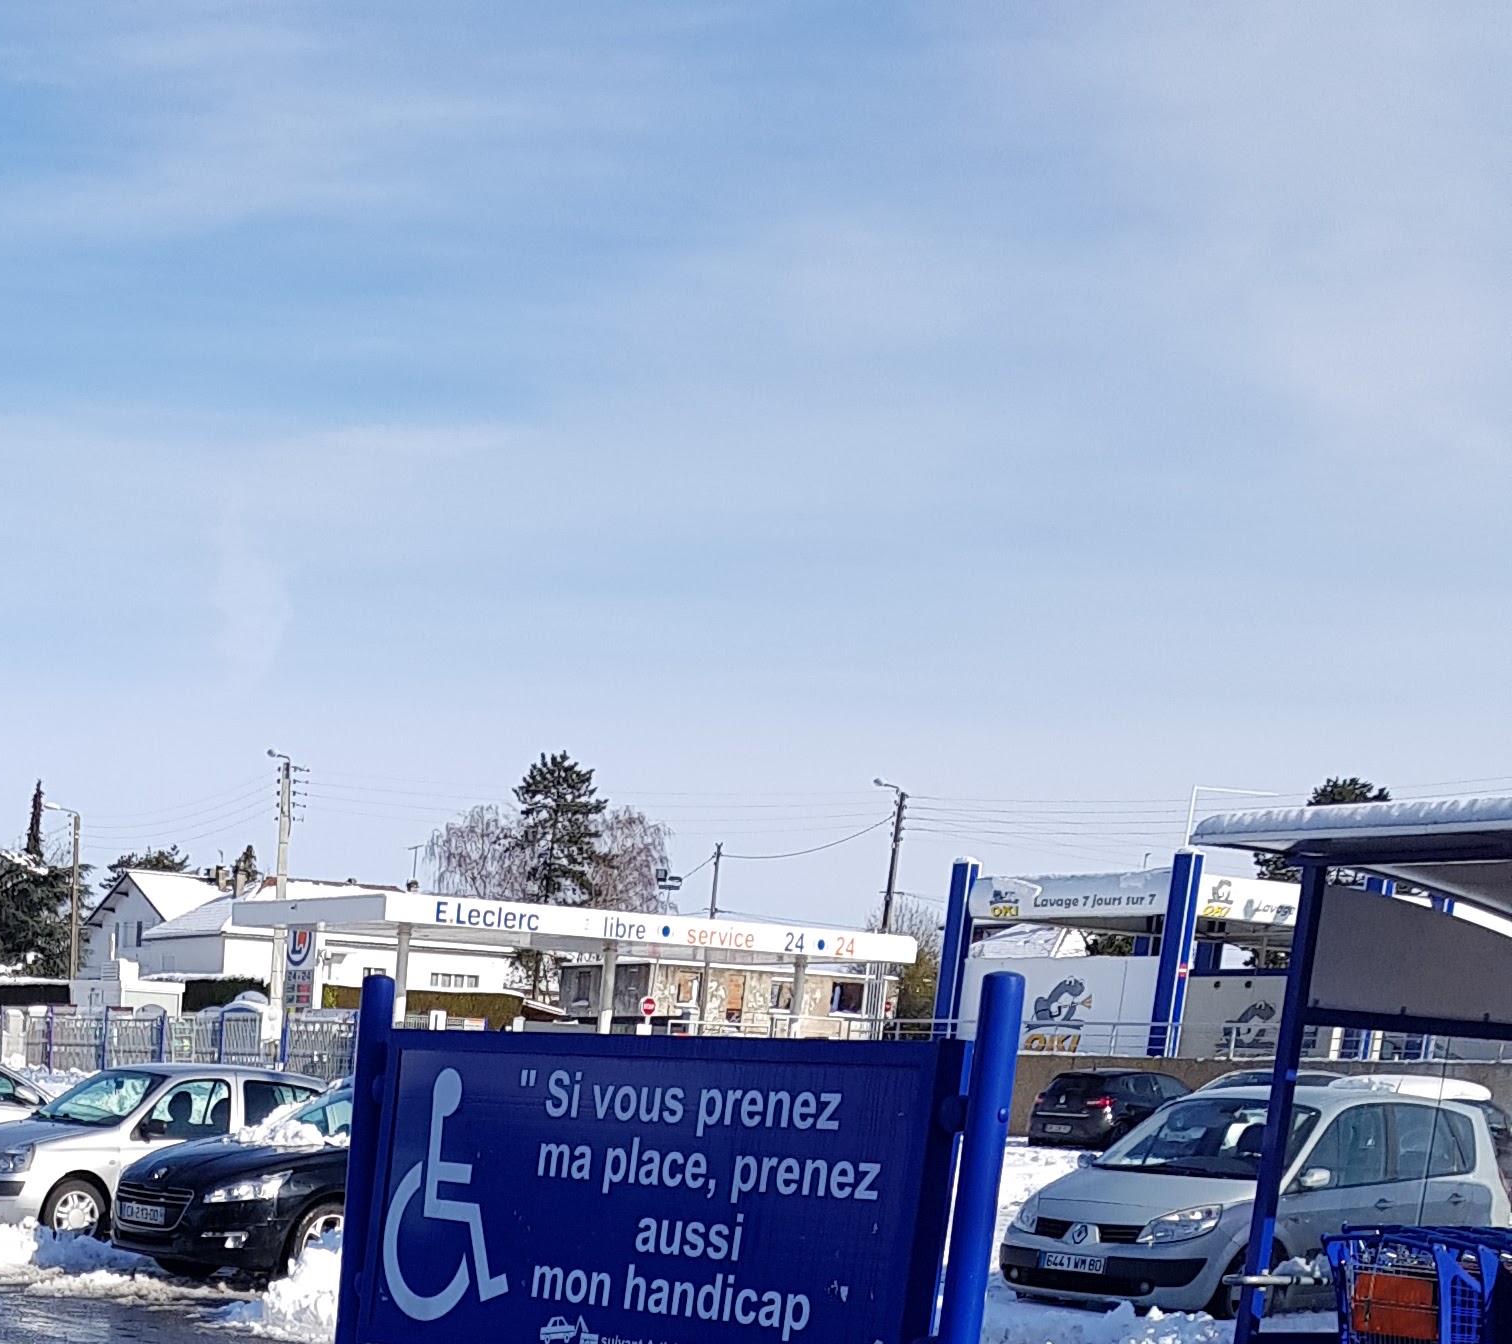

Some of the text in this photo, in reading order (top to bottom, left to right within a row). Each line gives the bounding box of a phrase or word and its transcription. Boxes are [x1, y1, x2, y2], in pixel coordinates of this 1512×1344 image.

[1034, 894, 1156, 908] Lavage 7 jours sur 7
[435, 901, 856, 957] E.Leclerc libre service 24 24
[593, 1085, 685, 1124] vous
[696, 1088, 842, 1137] prenez
[537, 1136, 881, 1204] ma place, prenez
[635, 1213, 744, 1261] aussi
[1047, 1254, 1072, 1268] 6441
[530, 1264, 611, 1307] mon
[623, 1264, 810, 1342] handicap
